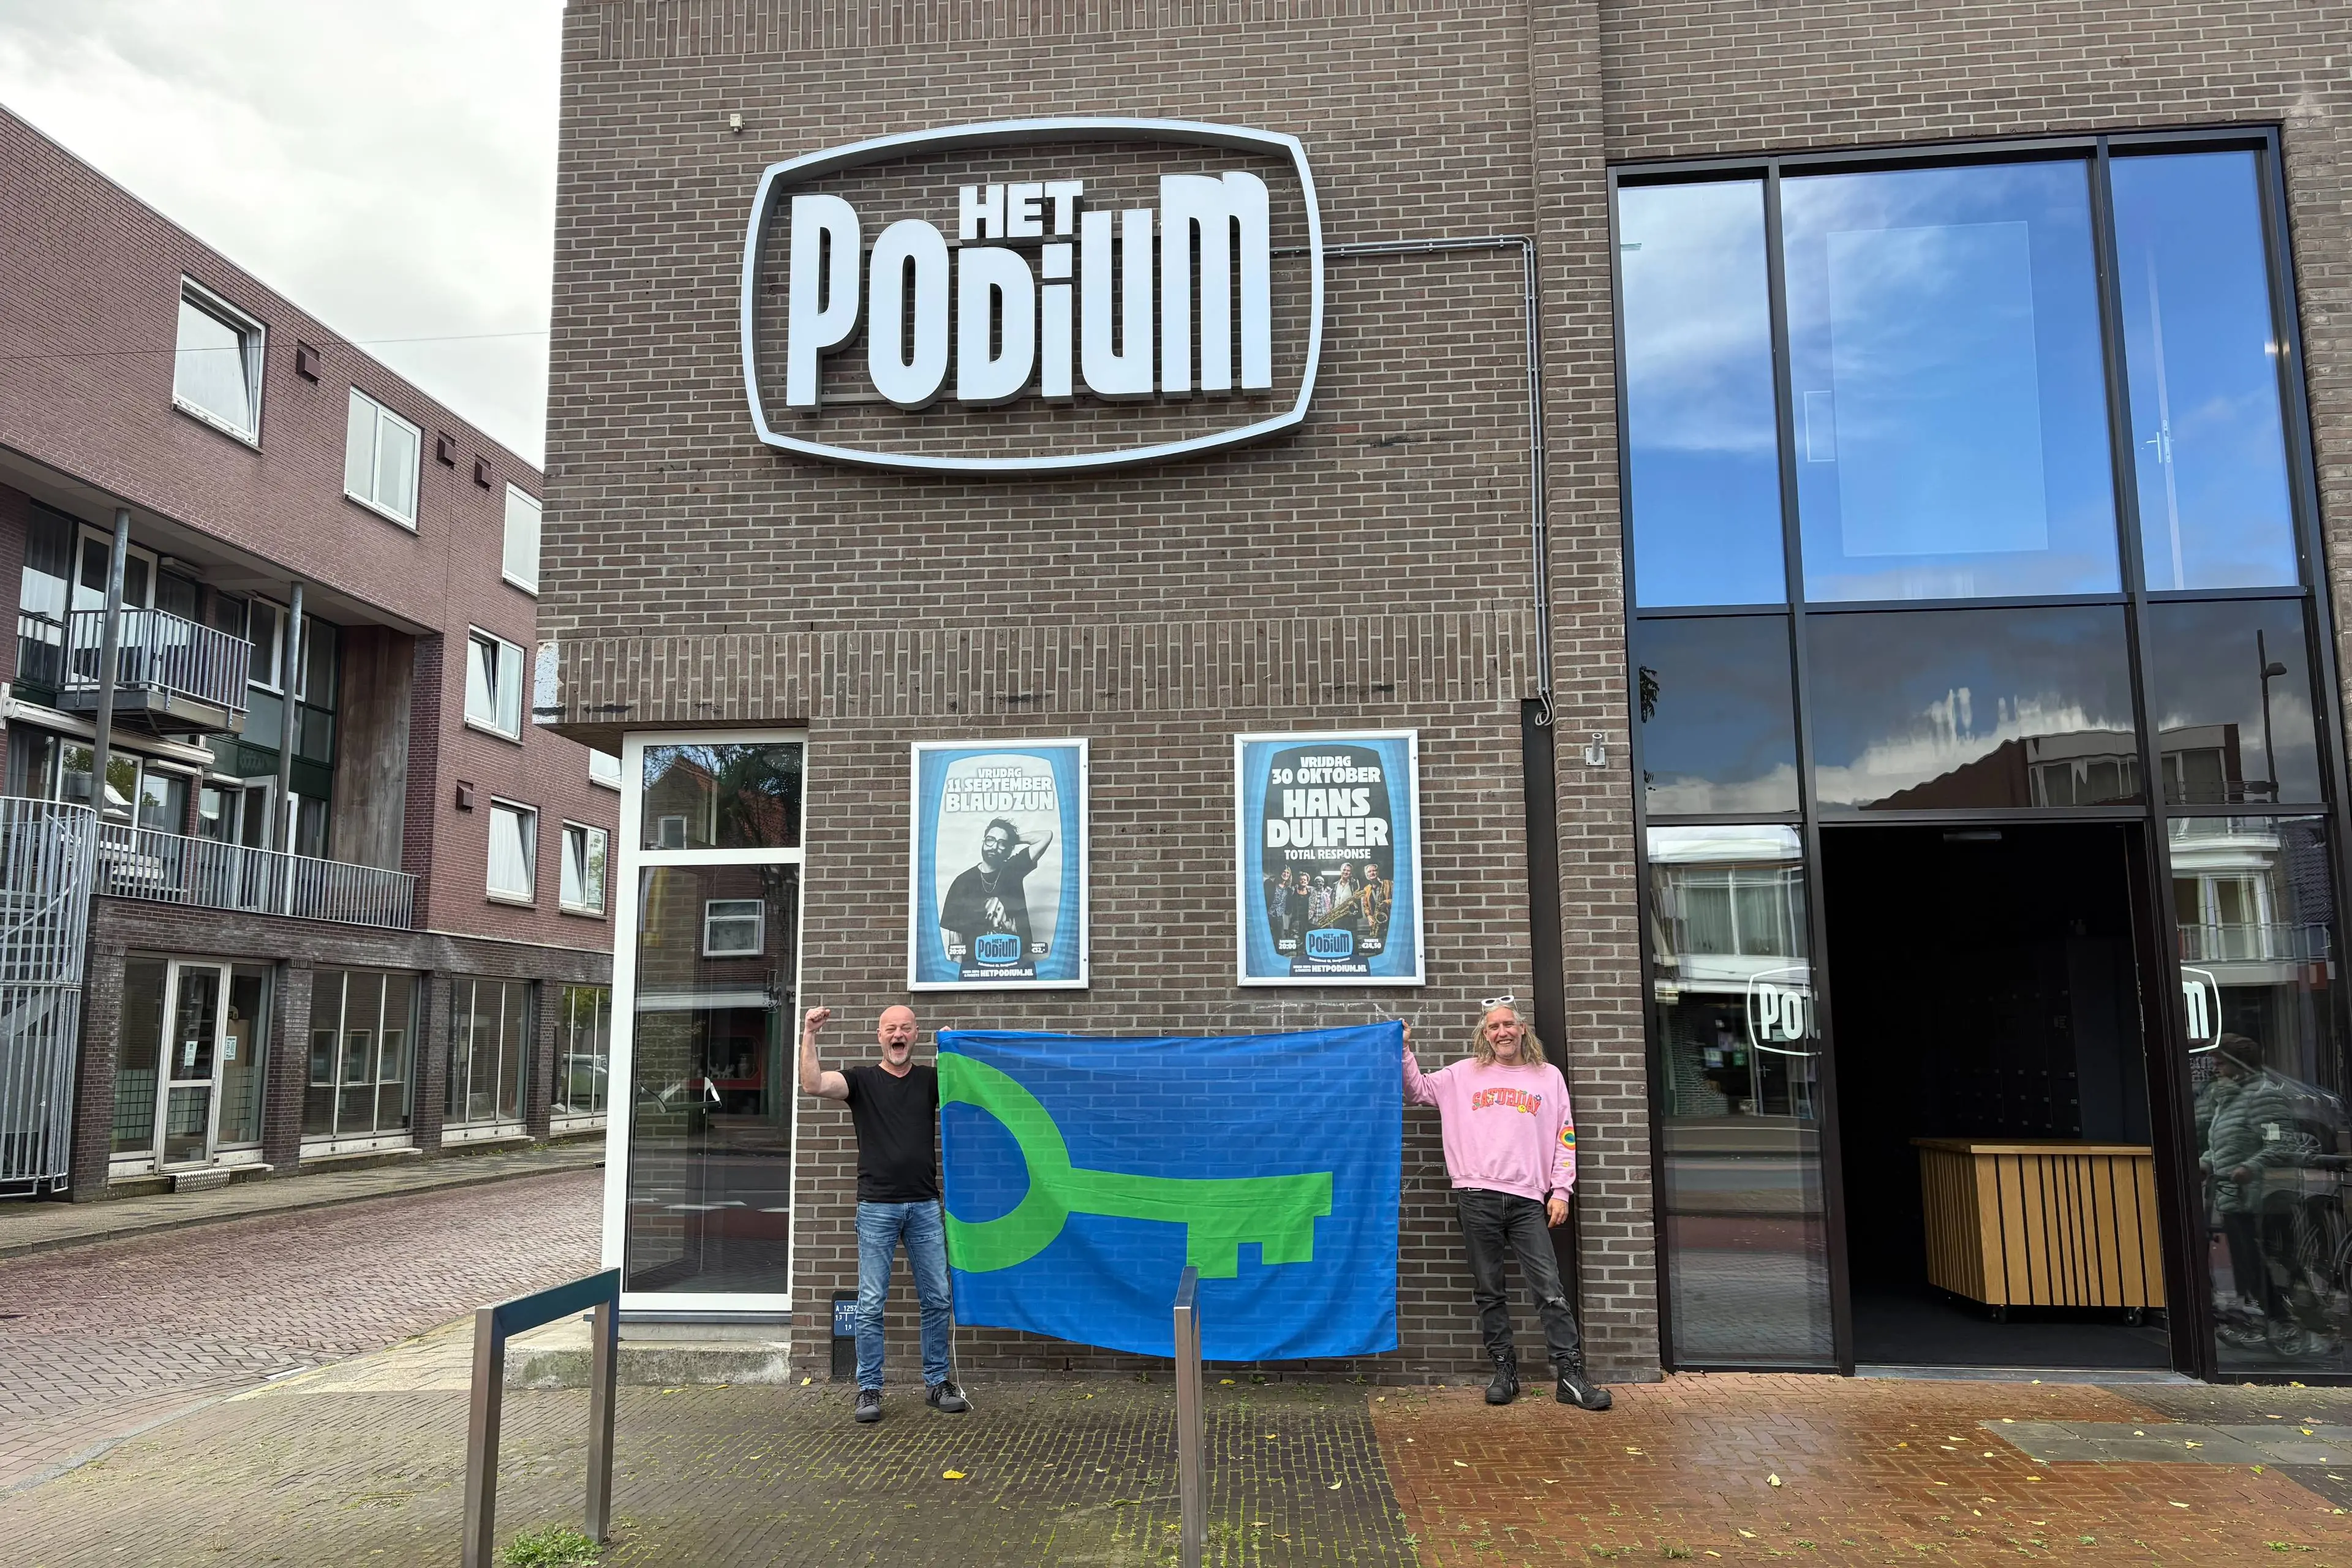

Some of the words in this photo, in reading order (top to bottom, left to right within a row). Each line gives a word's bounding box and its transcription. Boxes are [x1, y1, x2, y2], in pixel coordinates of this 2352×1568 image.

[959, 181, 1084, 239] HET
[1300, 756, 1351, 767] VRIJDAG
[947, 778, 962, 793] 11
[964, 777, 1052, 793] SEPTEMBER
[1272, 768, 1293, 785] 30
[1297, 767, 1381, 784] OKTOBER
[946, 791, 1054, 812] BLAUDZUN
[1283, 788, 1371, 818] HANS
[1267, 818, 1389, 848] DULFER
[1284, 849, 1316, 860] TOTAL
[1317, 848, 1371, 859] RESPONSE
[980, 968, 1033, 977] HETPODIUM.NL
[1311, 964, 1367, 973] HETPODIUM.NL
[1759, 983, 1809, 1039] PO
